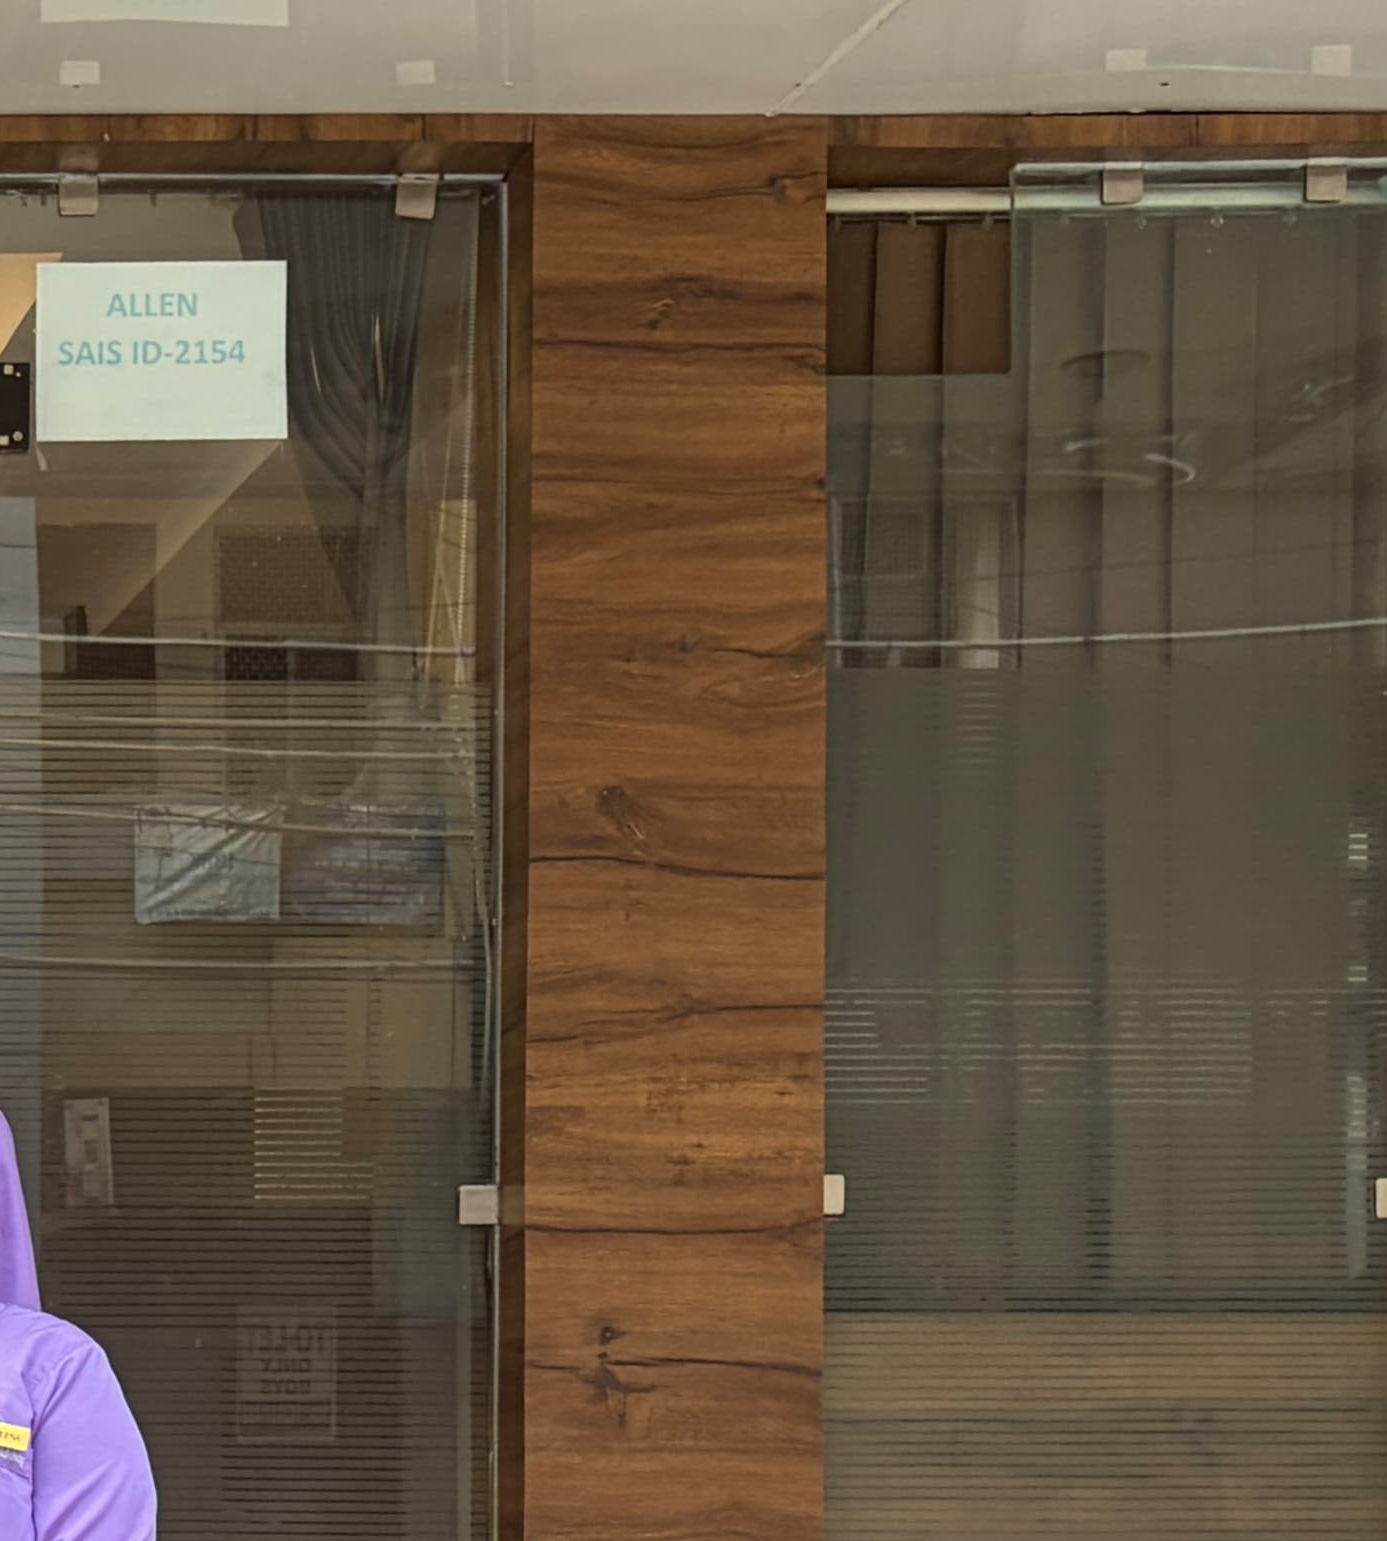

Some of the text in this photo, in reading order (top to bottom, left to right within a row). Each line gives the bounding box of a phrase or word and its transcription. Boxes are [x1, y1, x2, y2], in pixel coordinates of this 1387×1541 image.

[107, 292, 198, 318] ALLEN
[58, 339, 246, 367] SAIS ID-2154
